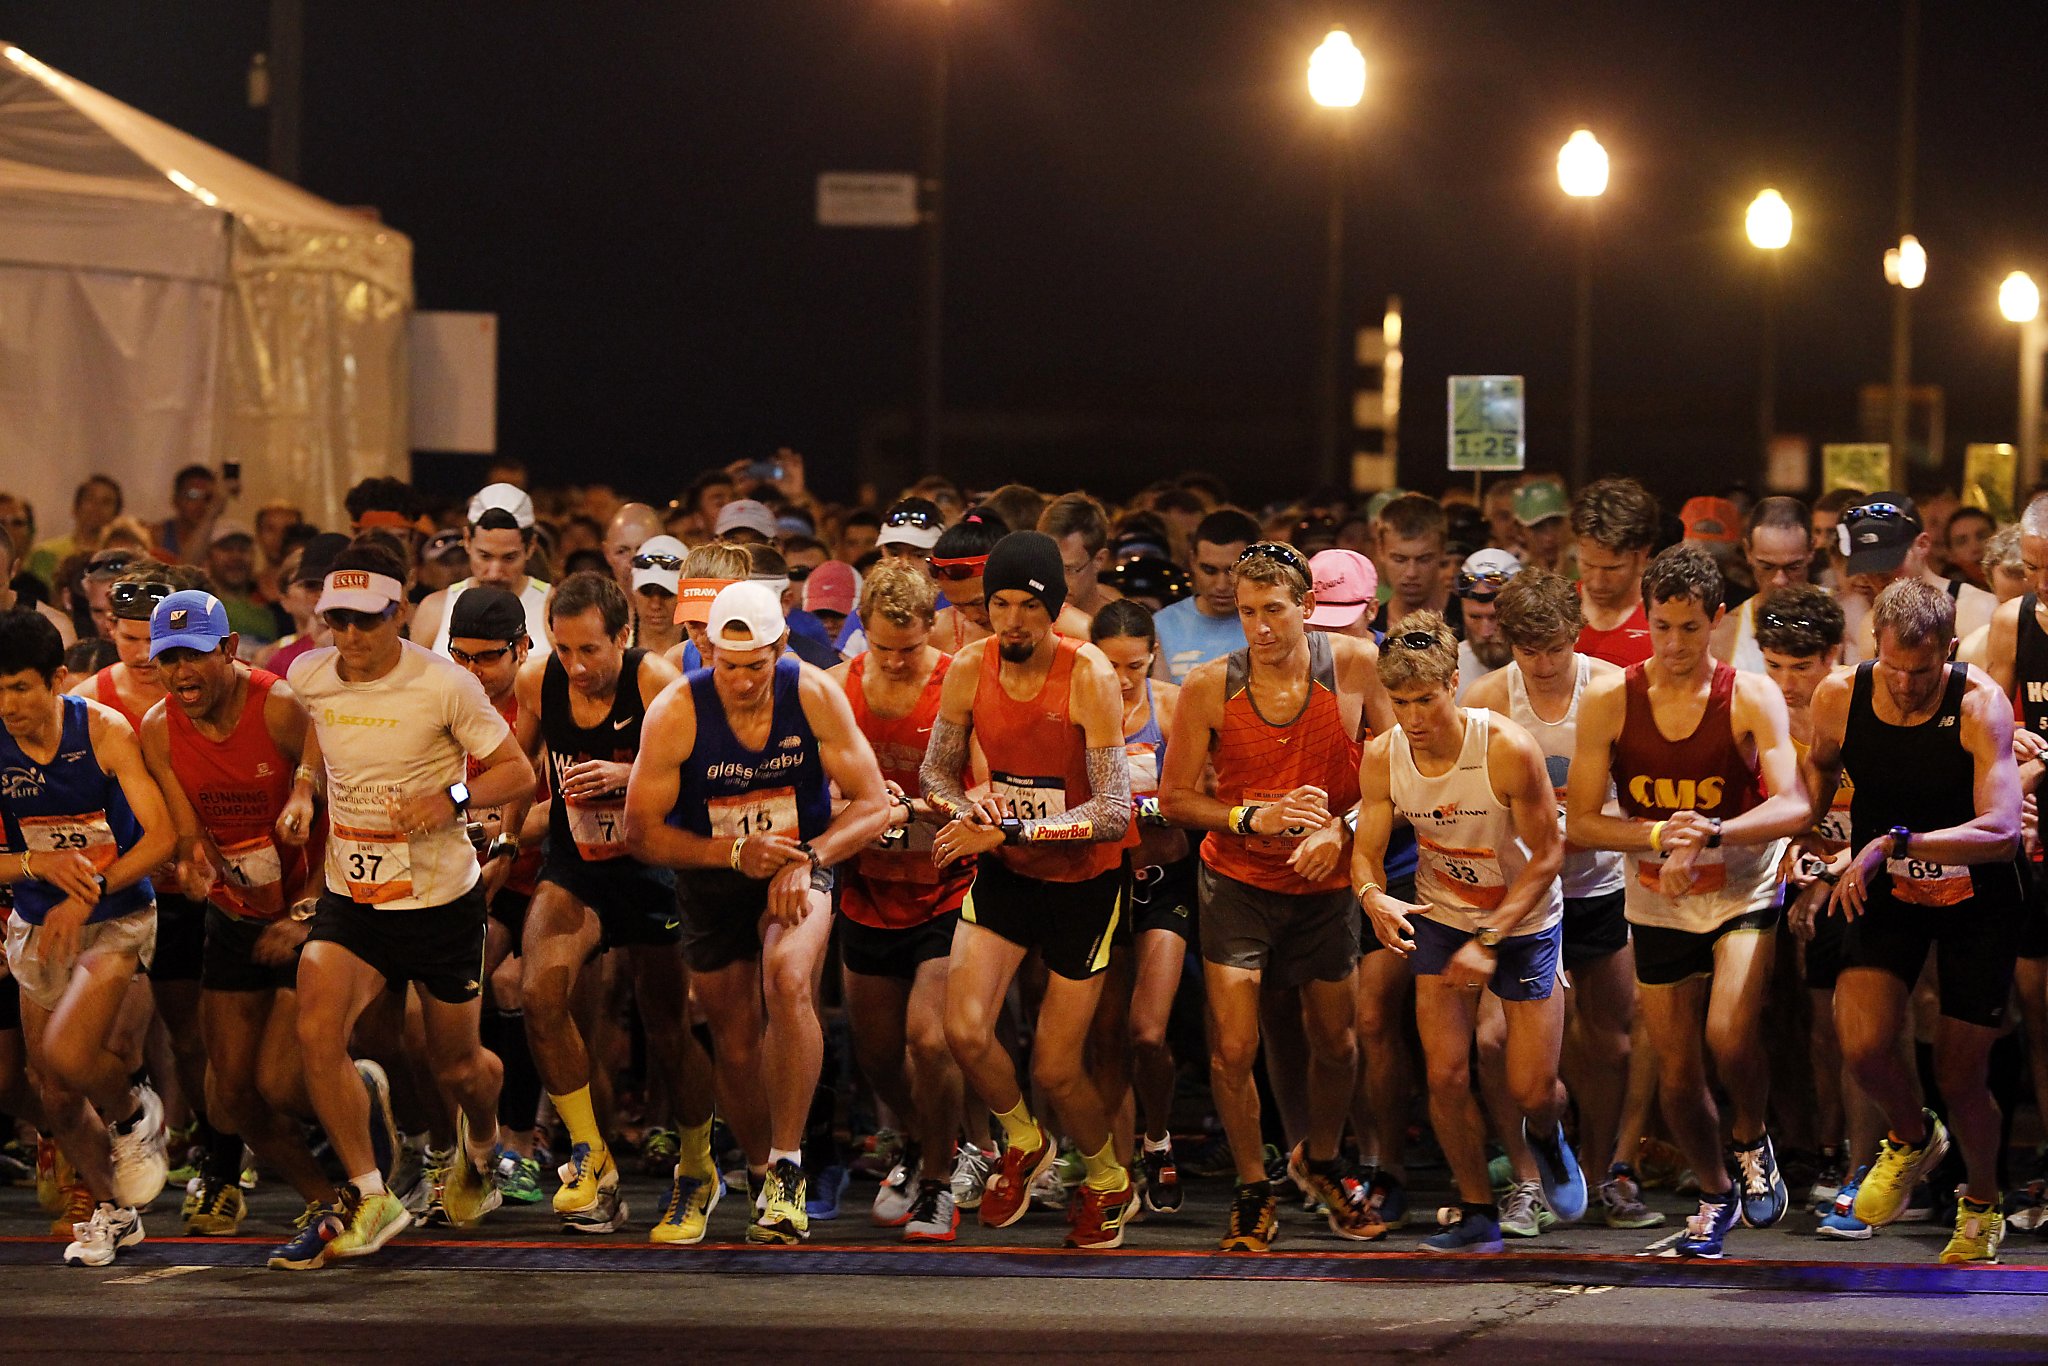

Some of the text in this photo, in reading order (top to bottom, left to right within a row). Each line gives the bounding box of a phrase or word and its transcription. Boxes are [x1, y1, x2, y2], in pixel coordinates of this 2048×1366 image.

[1457, 437, 1517, 457] 1:25
[684, 588, 717, 597] STRAVA
[337, 715, 400, 728] SCOTT
[199, 790, 268, 804] RUNNING
[1629, 775, 1726, 810] CMS
[204, 804, 268, 816] COMPANY
[1009, 799, 1046, 820] 131
[599, 821, 614, 842] 7
[737, 809, 772, 835] 15
[51, 833, 87, 849] 29
[1036, 825, 1090, 839] PowerBar
[349, 854, 383, 881] 37
[1445, 862, 1479, 884] 33
[1908, 860, 1942, 879] 69
